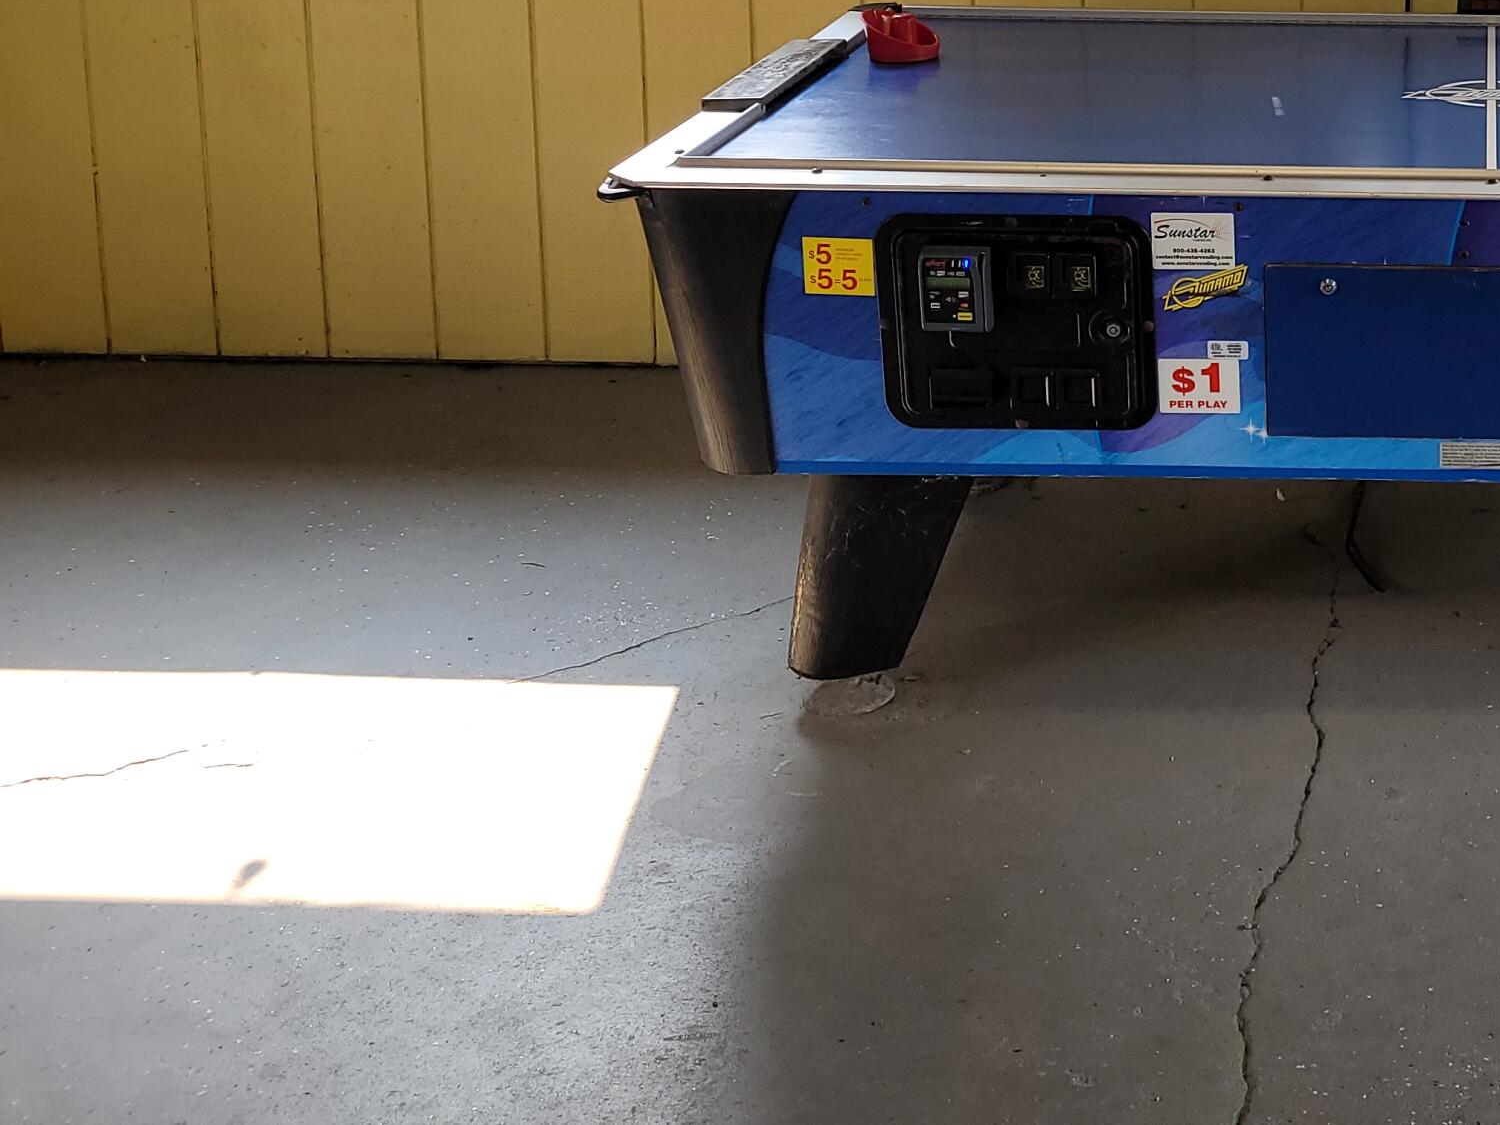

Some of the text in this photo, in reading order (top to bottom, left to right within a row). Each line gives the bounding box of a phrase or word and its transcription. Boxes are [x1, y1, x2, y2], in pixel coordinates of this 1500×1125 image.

[1154, 224, 1217, 239] Sunstar
[808, 243, 832, 265] $5
[1171, 362, 1221, 396] $1
[1169, 400, 1228, 409] PER PLAY
